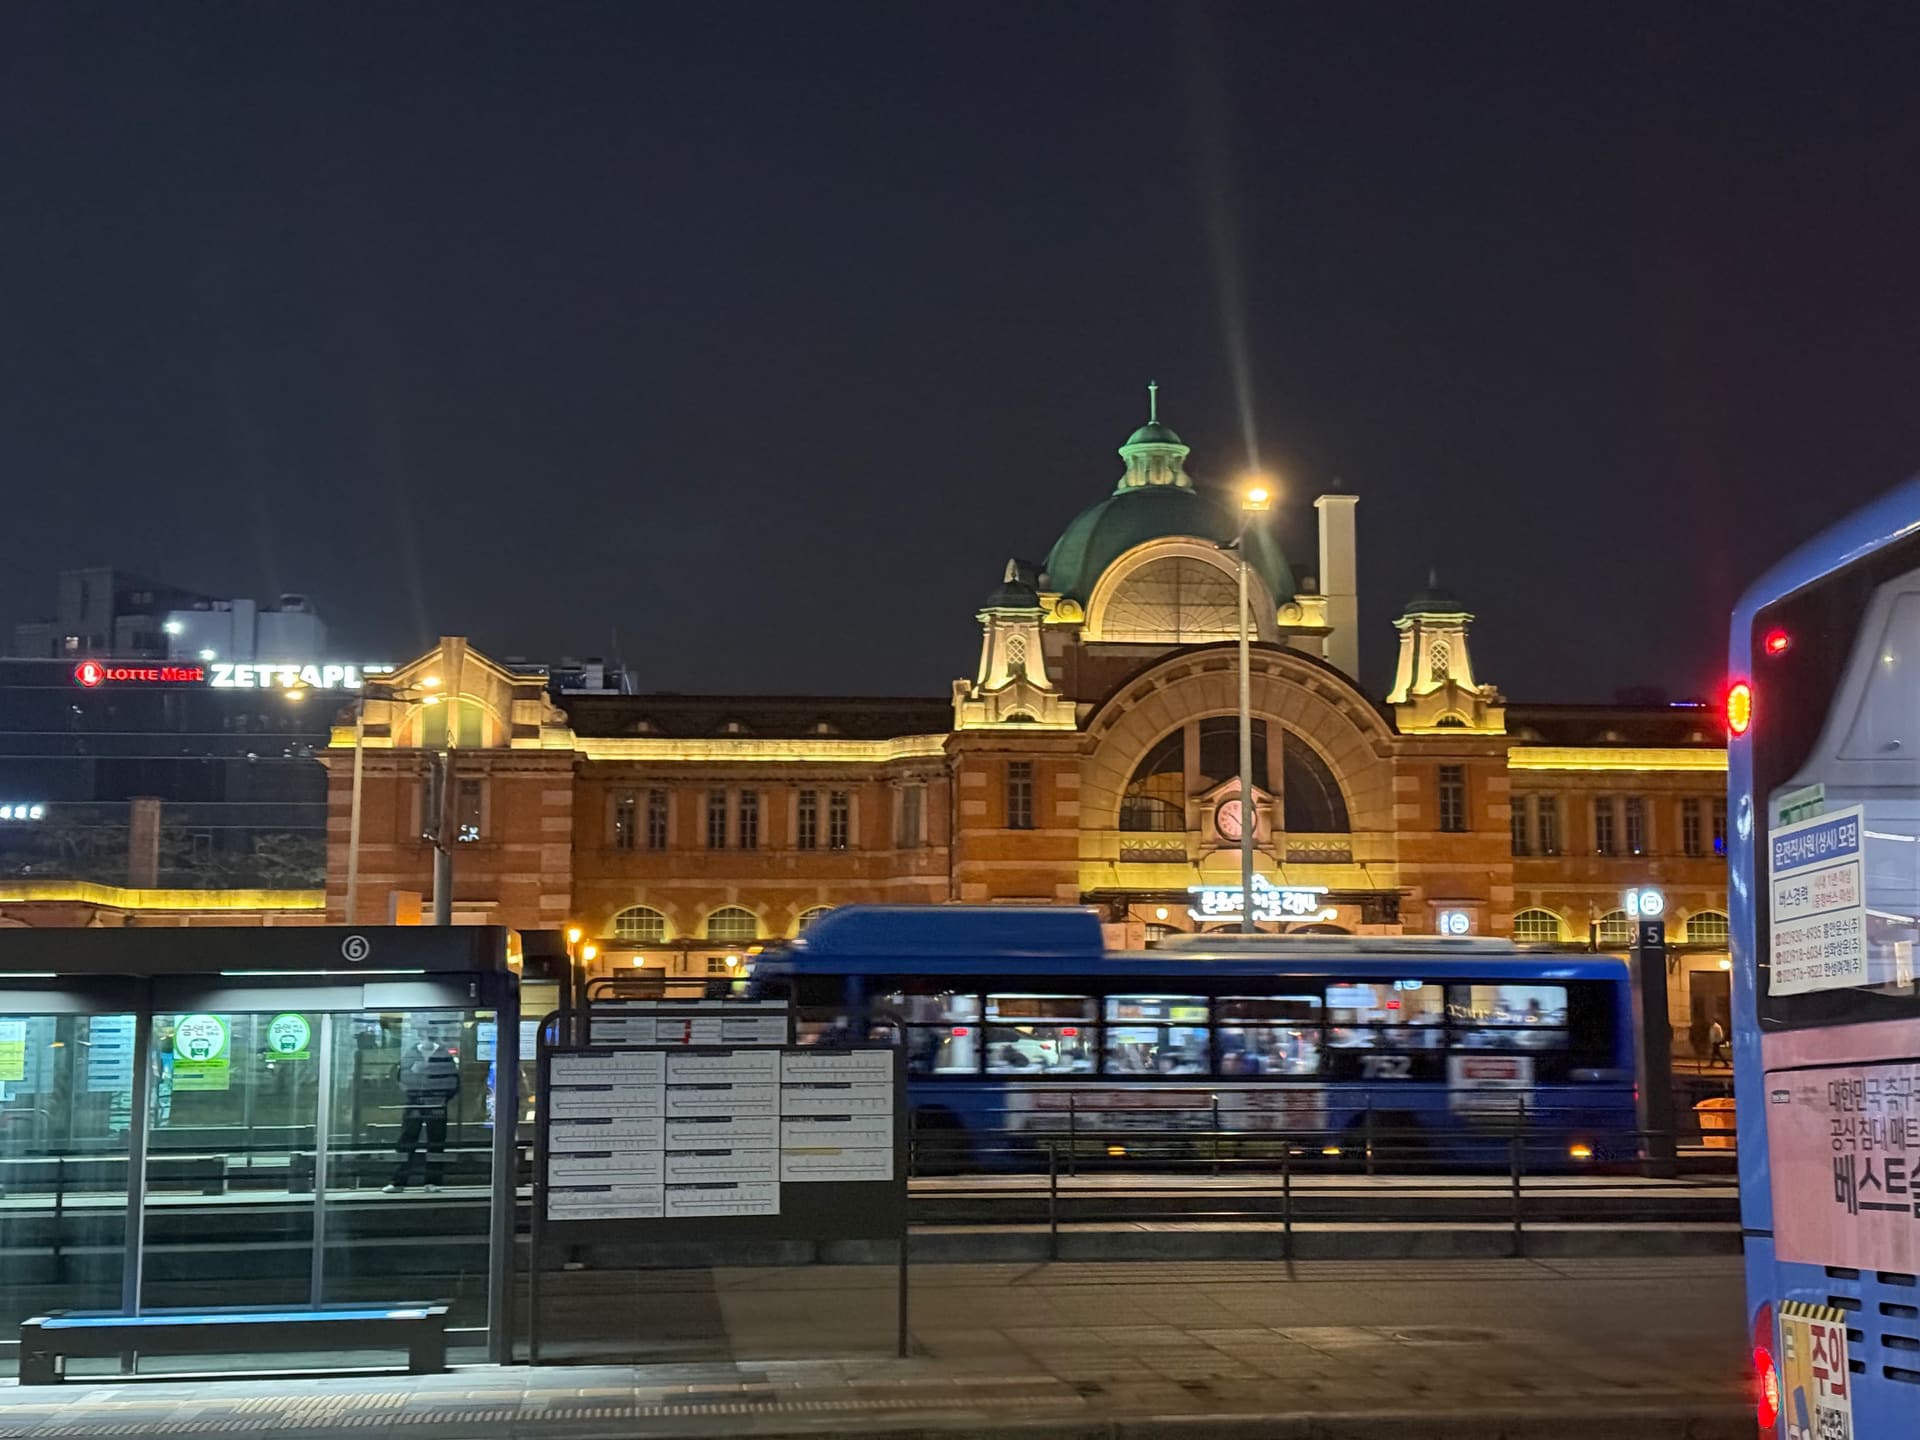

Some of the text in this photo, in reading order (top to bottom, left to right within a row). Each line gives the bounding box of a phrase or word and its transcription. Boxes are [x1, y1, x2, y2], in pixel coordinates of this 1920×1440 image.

[106, 667, 204, 682] LOTTE Mart
[210, 664, 394, 688] ZETTAPL
[1775, 823, 1856, 866] 운전직사원(상시) 모집
[1779, 886, 1808, 908] 버스경력
[1647, 926, 1659, 943] 5
[1828, 1077, 1882, 1112] 대한민국
[1829, 1117, 1857, 1151] 공식
[1858, 1116, 1888, 1151] 침대
[1811, 1324, 1848, 1400] 주의
